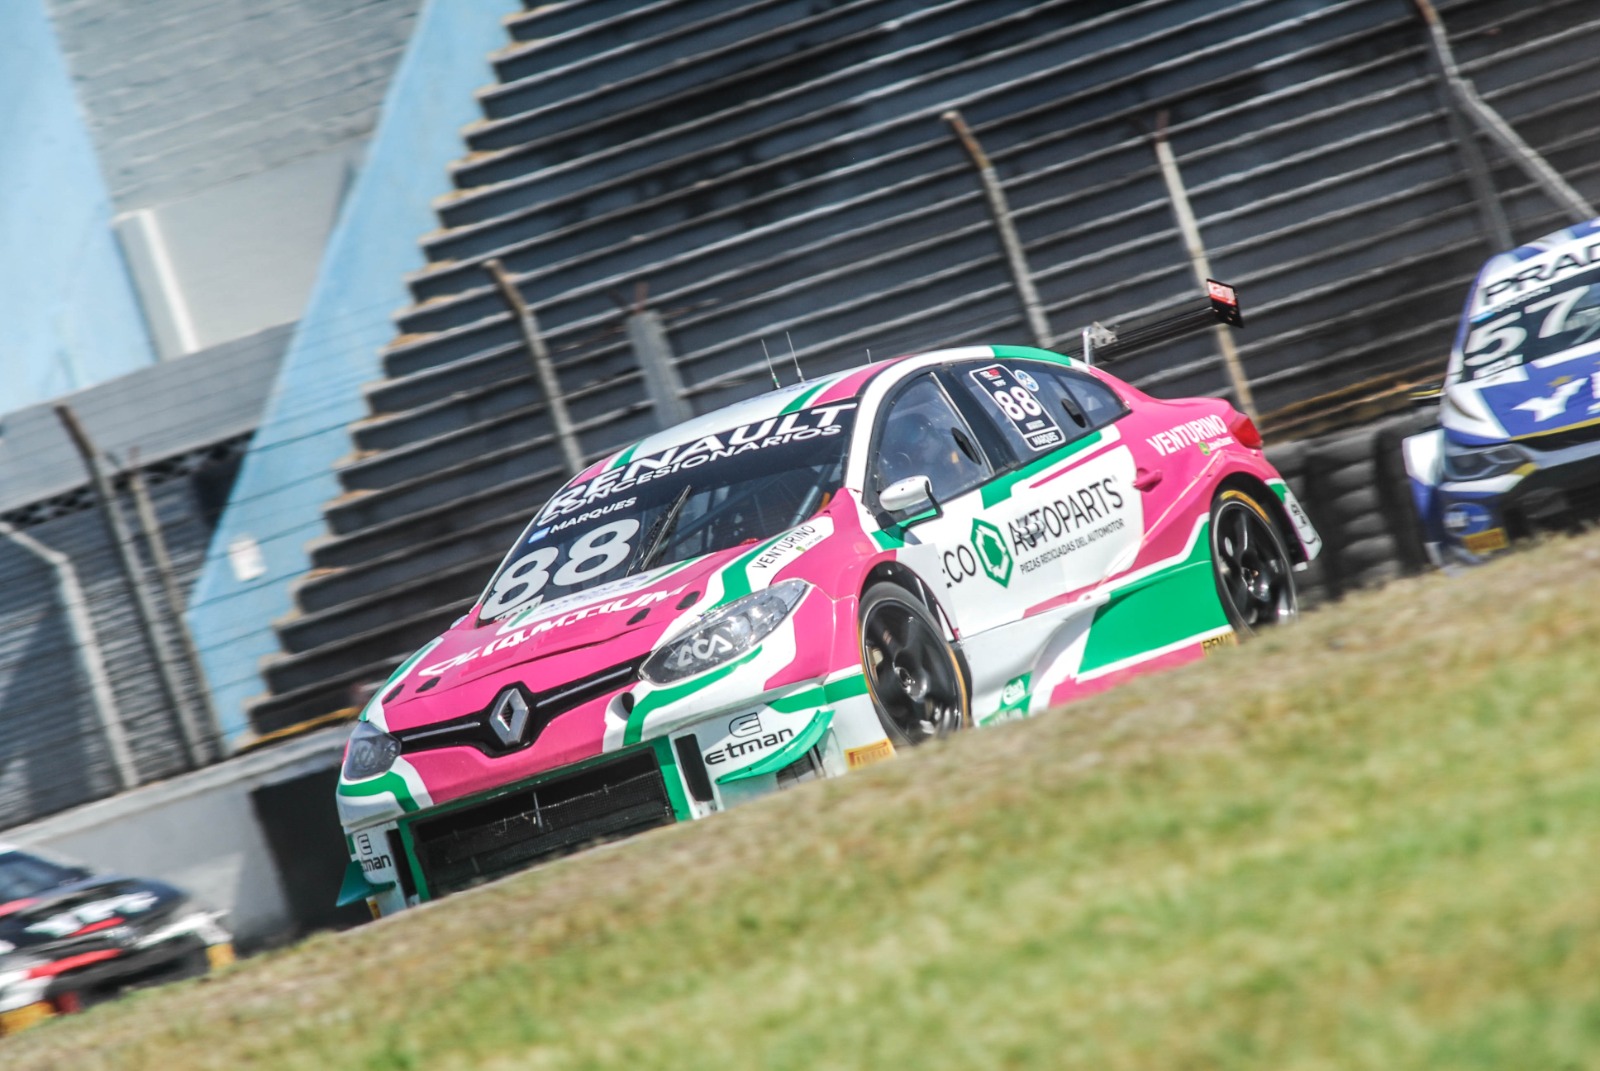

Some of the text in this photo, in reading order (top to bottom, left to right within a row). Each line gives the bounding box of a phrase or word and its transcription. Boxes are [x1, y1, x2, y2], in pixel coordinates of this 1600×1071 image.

[1463, 284, 1590, 367] 57
[994, 386, 1042, 421] 88
[541, 401, 858, 520] RENAULT
[1145, 414, 1228, 457] VENTURINO
[537, 424, 842, 527] CONCESIONARIOS
[550, 497, 638, 532] MARQUES
[1008, 477, 1124, 556] AUTOPARTS
[479, 519, 640, 620] 88
[752, 525, 816, 568] VENTURINO
[1020, 557, 1042, 575] PIEZAS
[1074, 536, 1089, 549] DEL
[1087, 518, 1125, 543] AUTOMOTOR
[705, 728, 794, 766] etman
